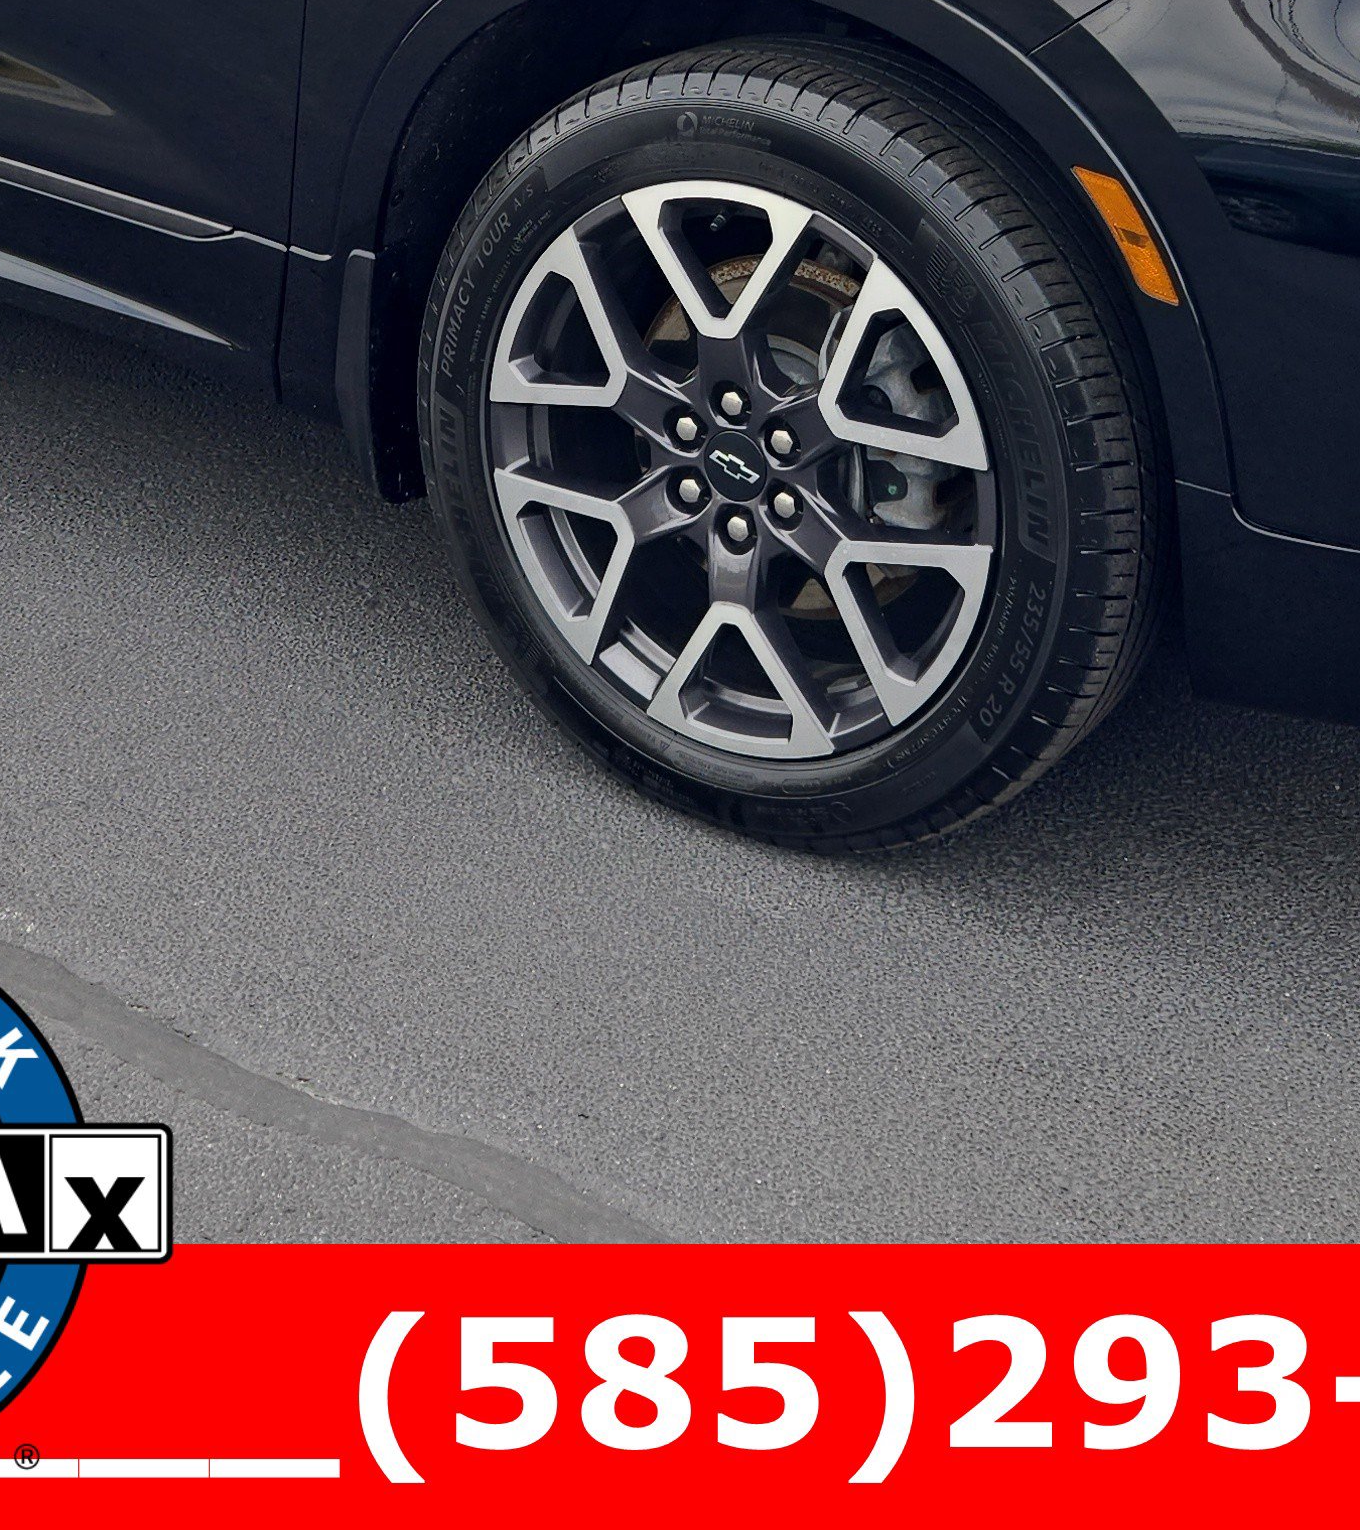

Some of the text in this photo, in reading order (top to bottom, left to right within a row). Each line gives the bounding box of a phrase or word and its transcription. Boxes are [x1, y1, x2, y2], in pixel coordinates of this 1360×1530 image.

[440, 269, 476, 379] PRIMACY
[475, 210, 512, 270] TOUR
[1008, 580, 1047, 675] 235/55
[979, 692, 1003, 728] 20
[998, 672, 1017, 696] R
